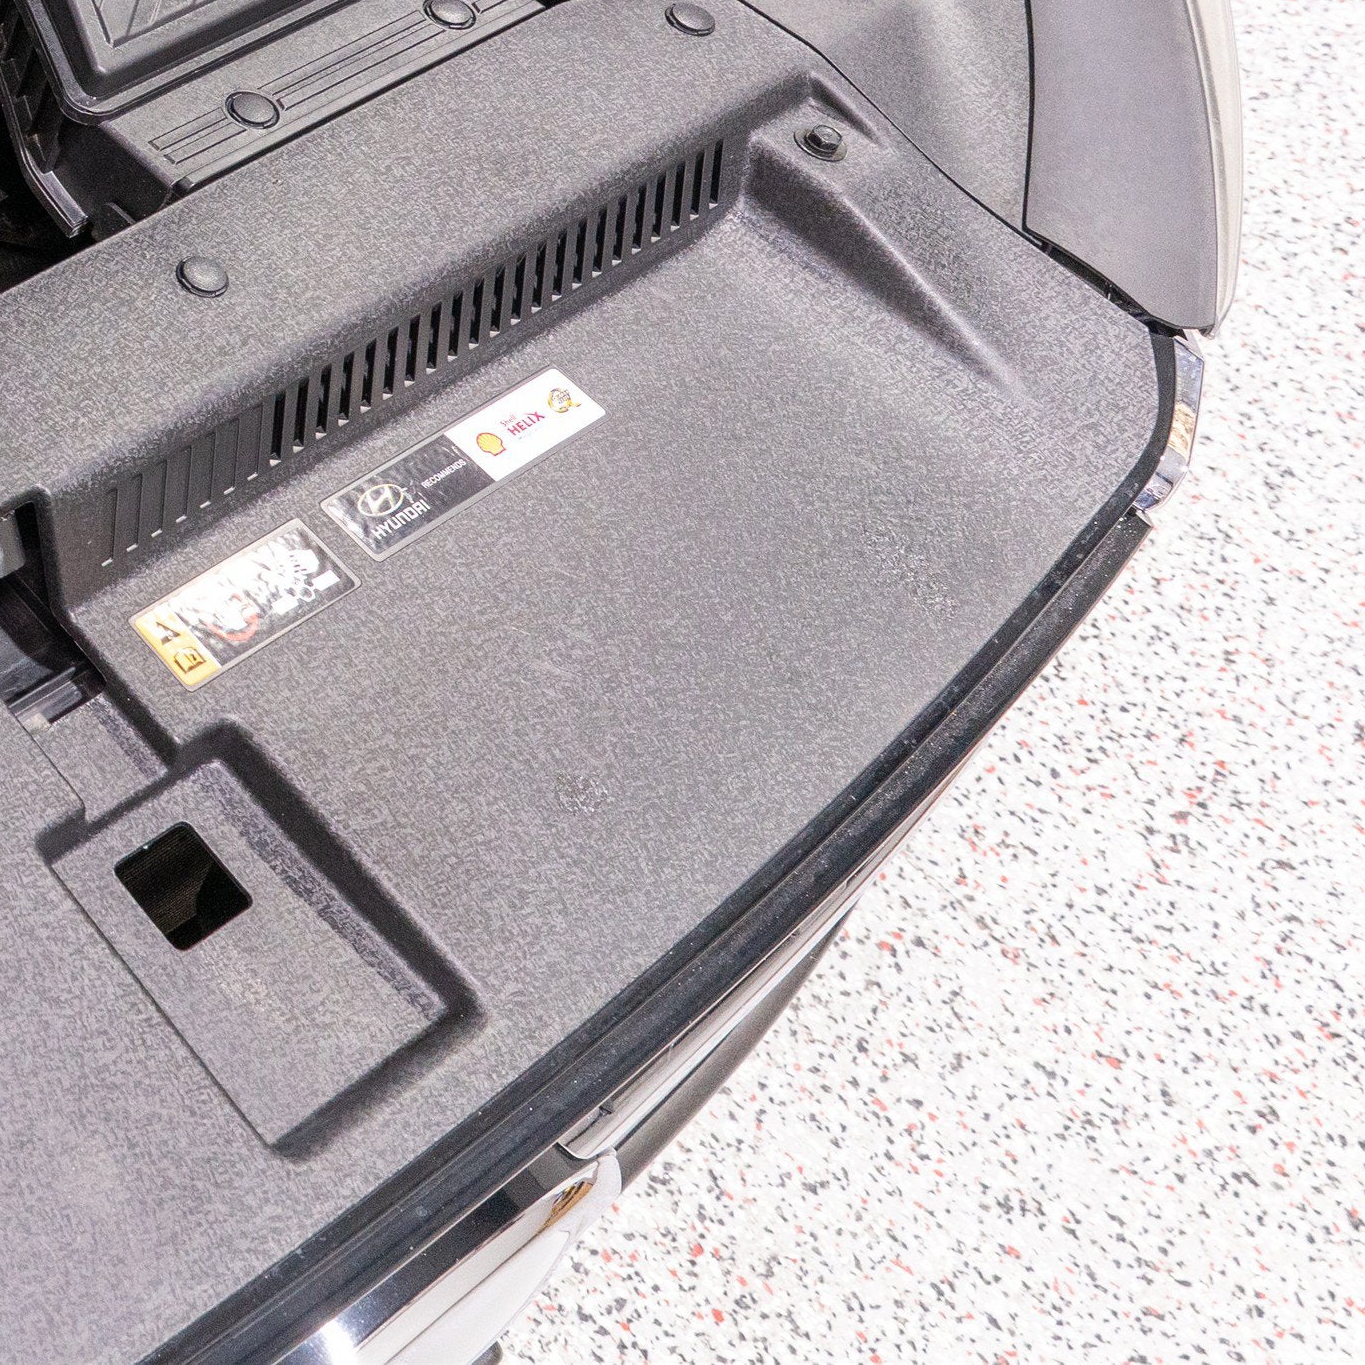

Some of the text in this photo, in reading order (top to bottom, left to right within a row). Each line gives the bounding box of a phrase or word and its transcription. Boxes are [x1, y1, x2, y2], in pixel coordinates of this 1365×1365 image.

[506, 411, 546, 436] HELIX
[420, 458, 467, 489] RECOMMENDS
[370, 498, 432, 540] HYUNDAI
